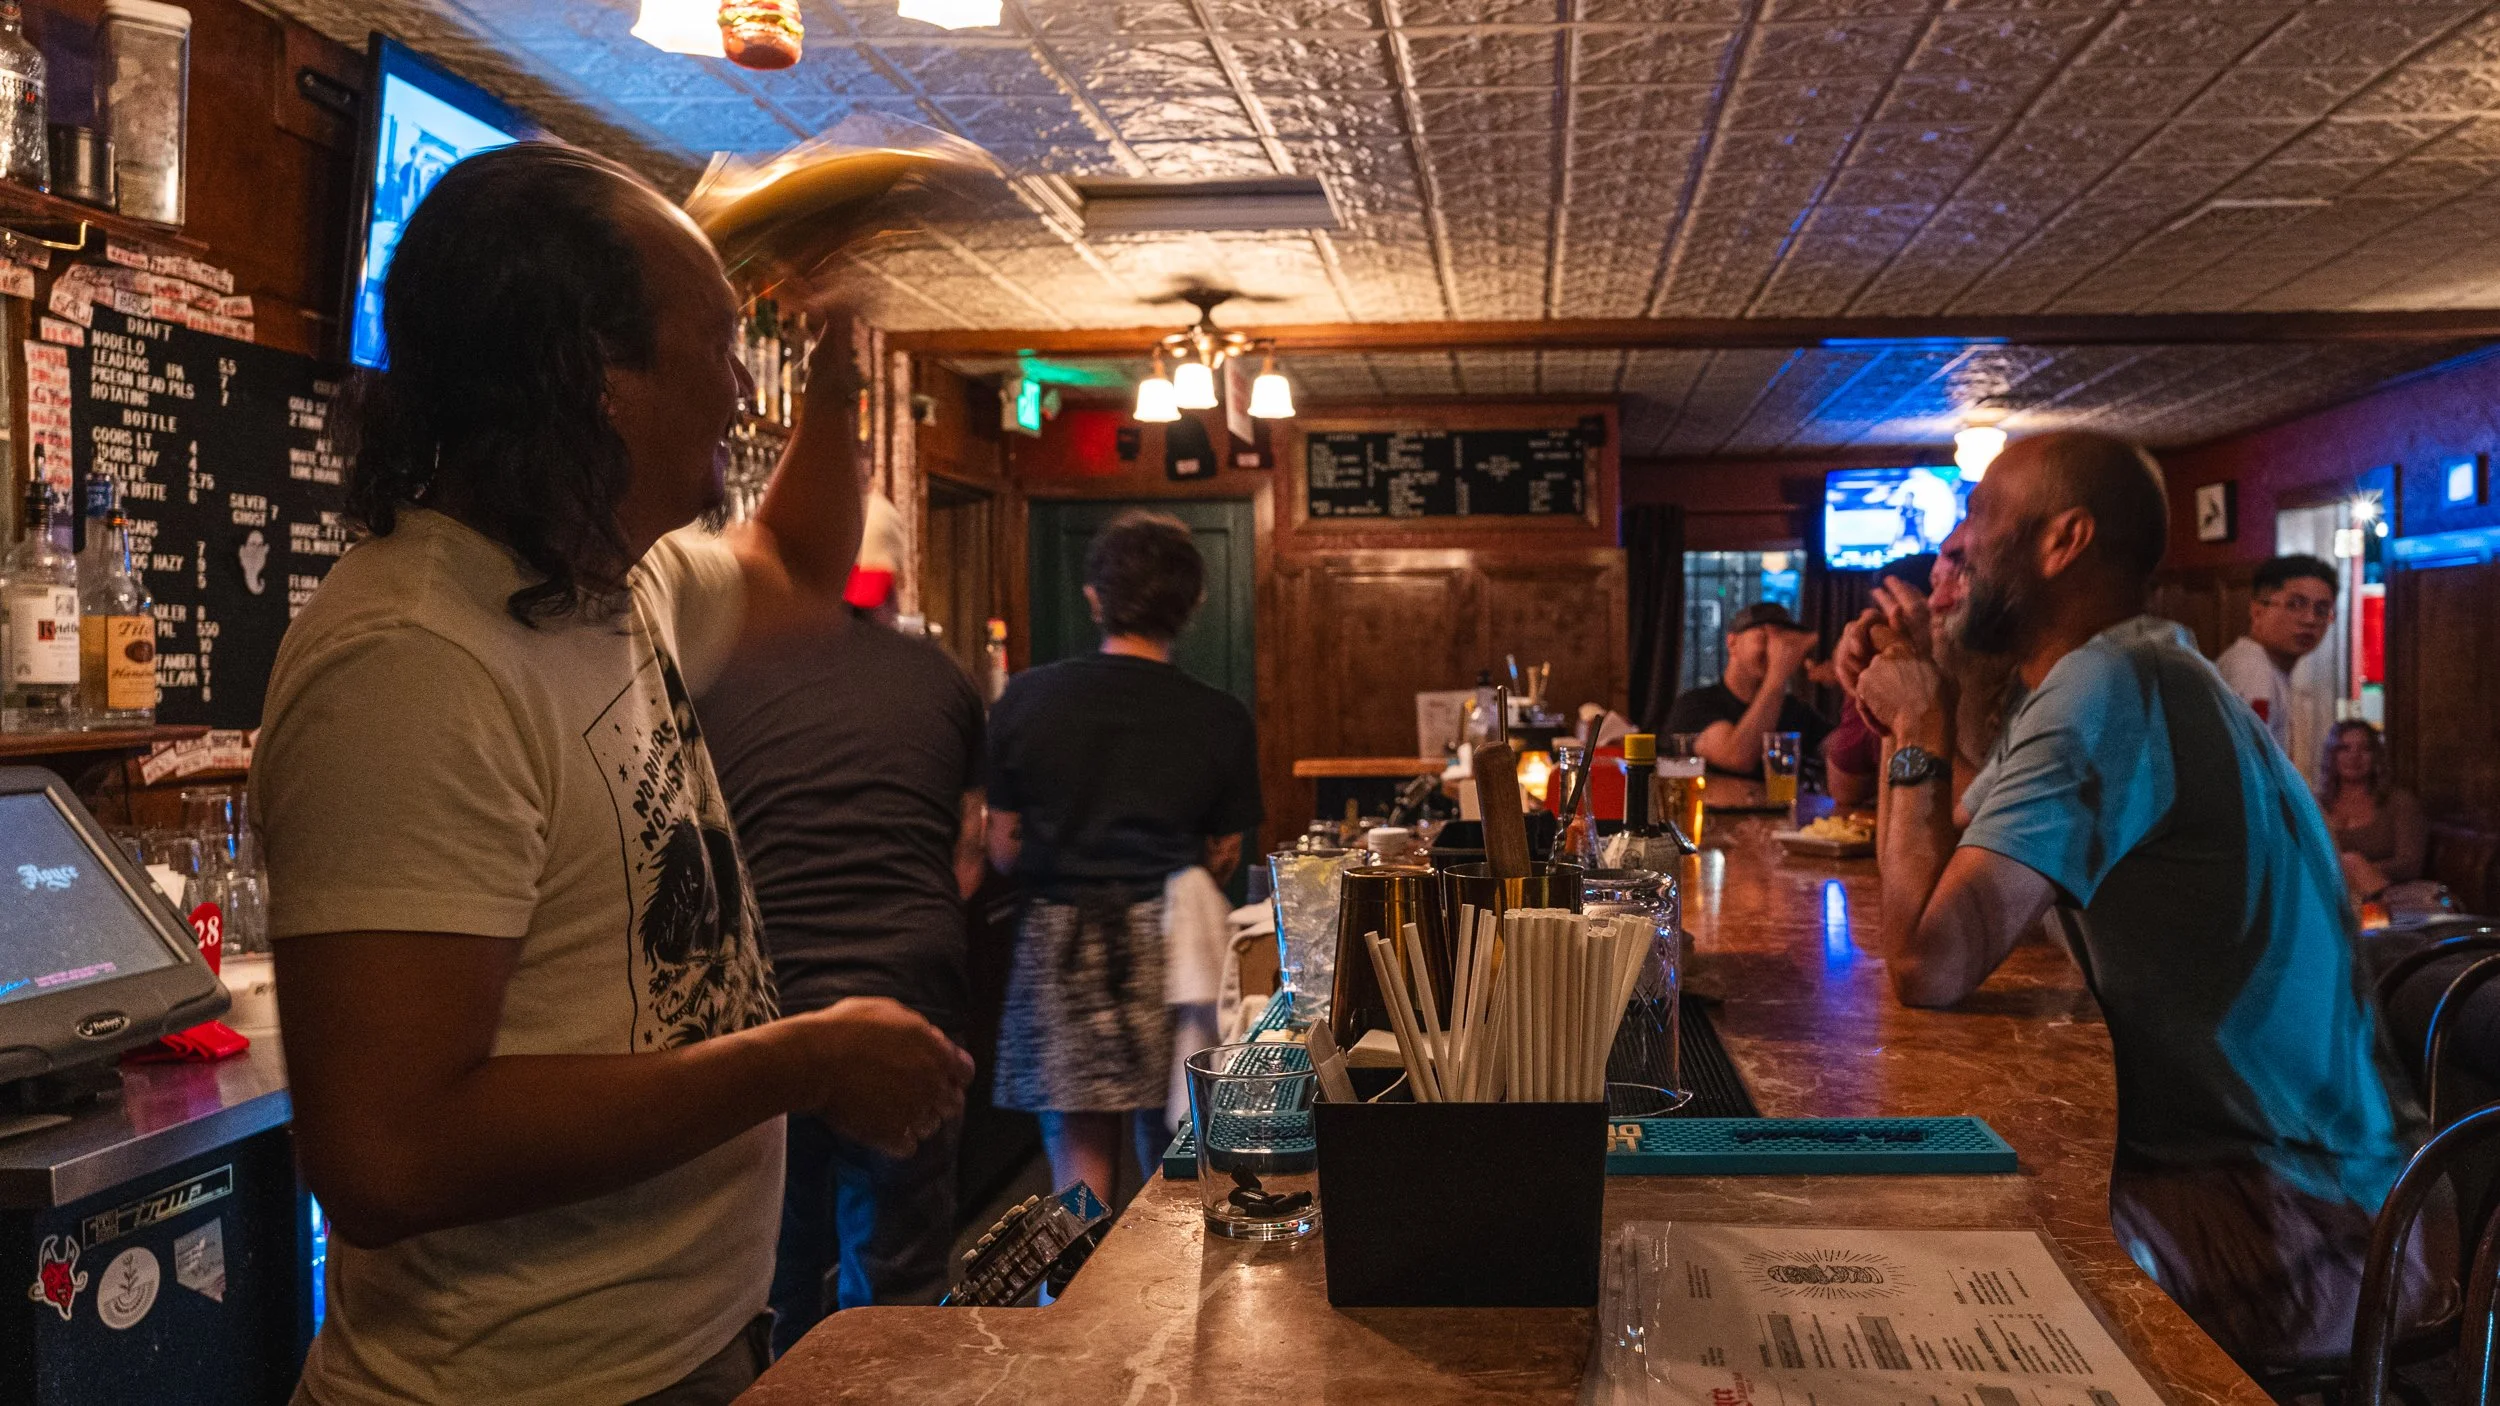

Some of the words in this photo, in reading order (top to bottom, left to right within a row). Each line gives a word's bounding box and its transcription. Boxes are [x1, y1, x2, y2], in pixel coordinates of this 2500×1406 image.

[127, 316, 173, 342] DRAFT
[91, 329, 146, 356] MODELO
[166, 362, 185, 381] IPA
[91, 381, 149, 408] ROTATING
[122, 408, 177, 433] BOTTLE
[92, 426, 133, 446] COORS
[136, 432, 153, 450] LT
[229, 493, 268, 511] SILVER
[127, 518, 159, 537] CANS
[231, 509, 267, 527] GHOST
[152, 553, 185, 572] HAZY
[153, 603, 187, 623] ADLER
[639, 806, 667, 852] NO
[194, 915, 220, 950] 28
